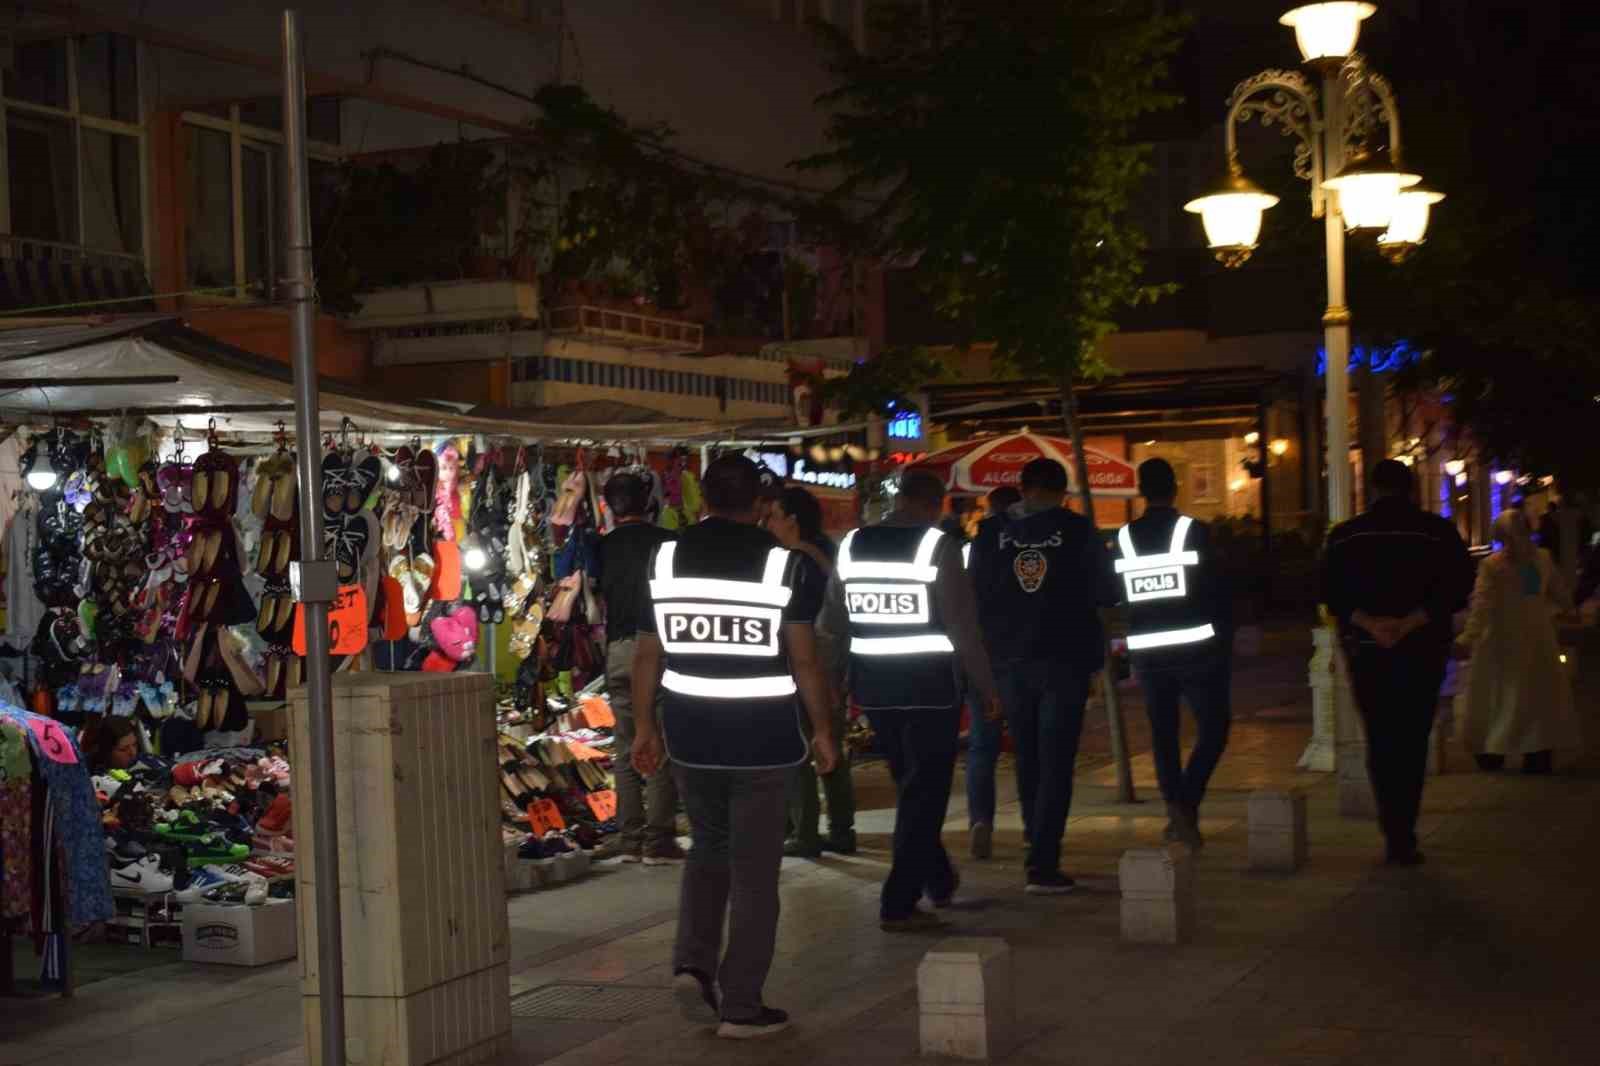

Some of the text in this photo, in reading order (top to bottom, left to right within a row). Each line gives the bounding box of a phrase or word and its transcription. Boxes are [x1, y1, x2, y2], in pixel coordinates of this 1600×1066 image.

[849, 592, 915, 614] POLiS
[669, 614, 764, 644] POLiS
[43, 724, 63, 755] 5
